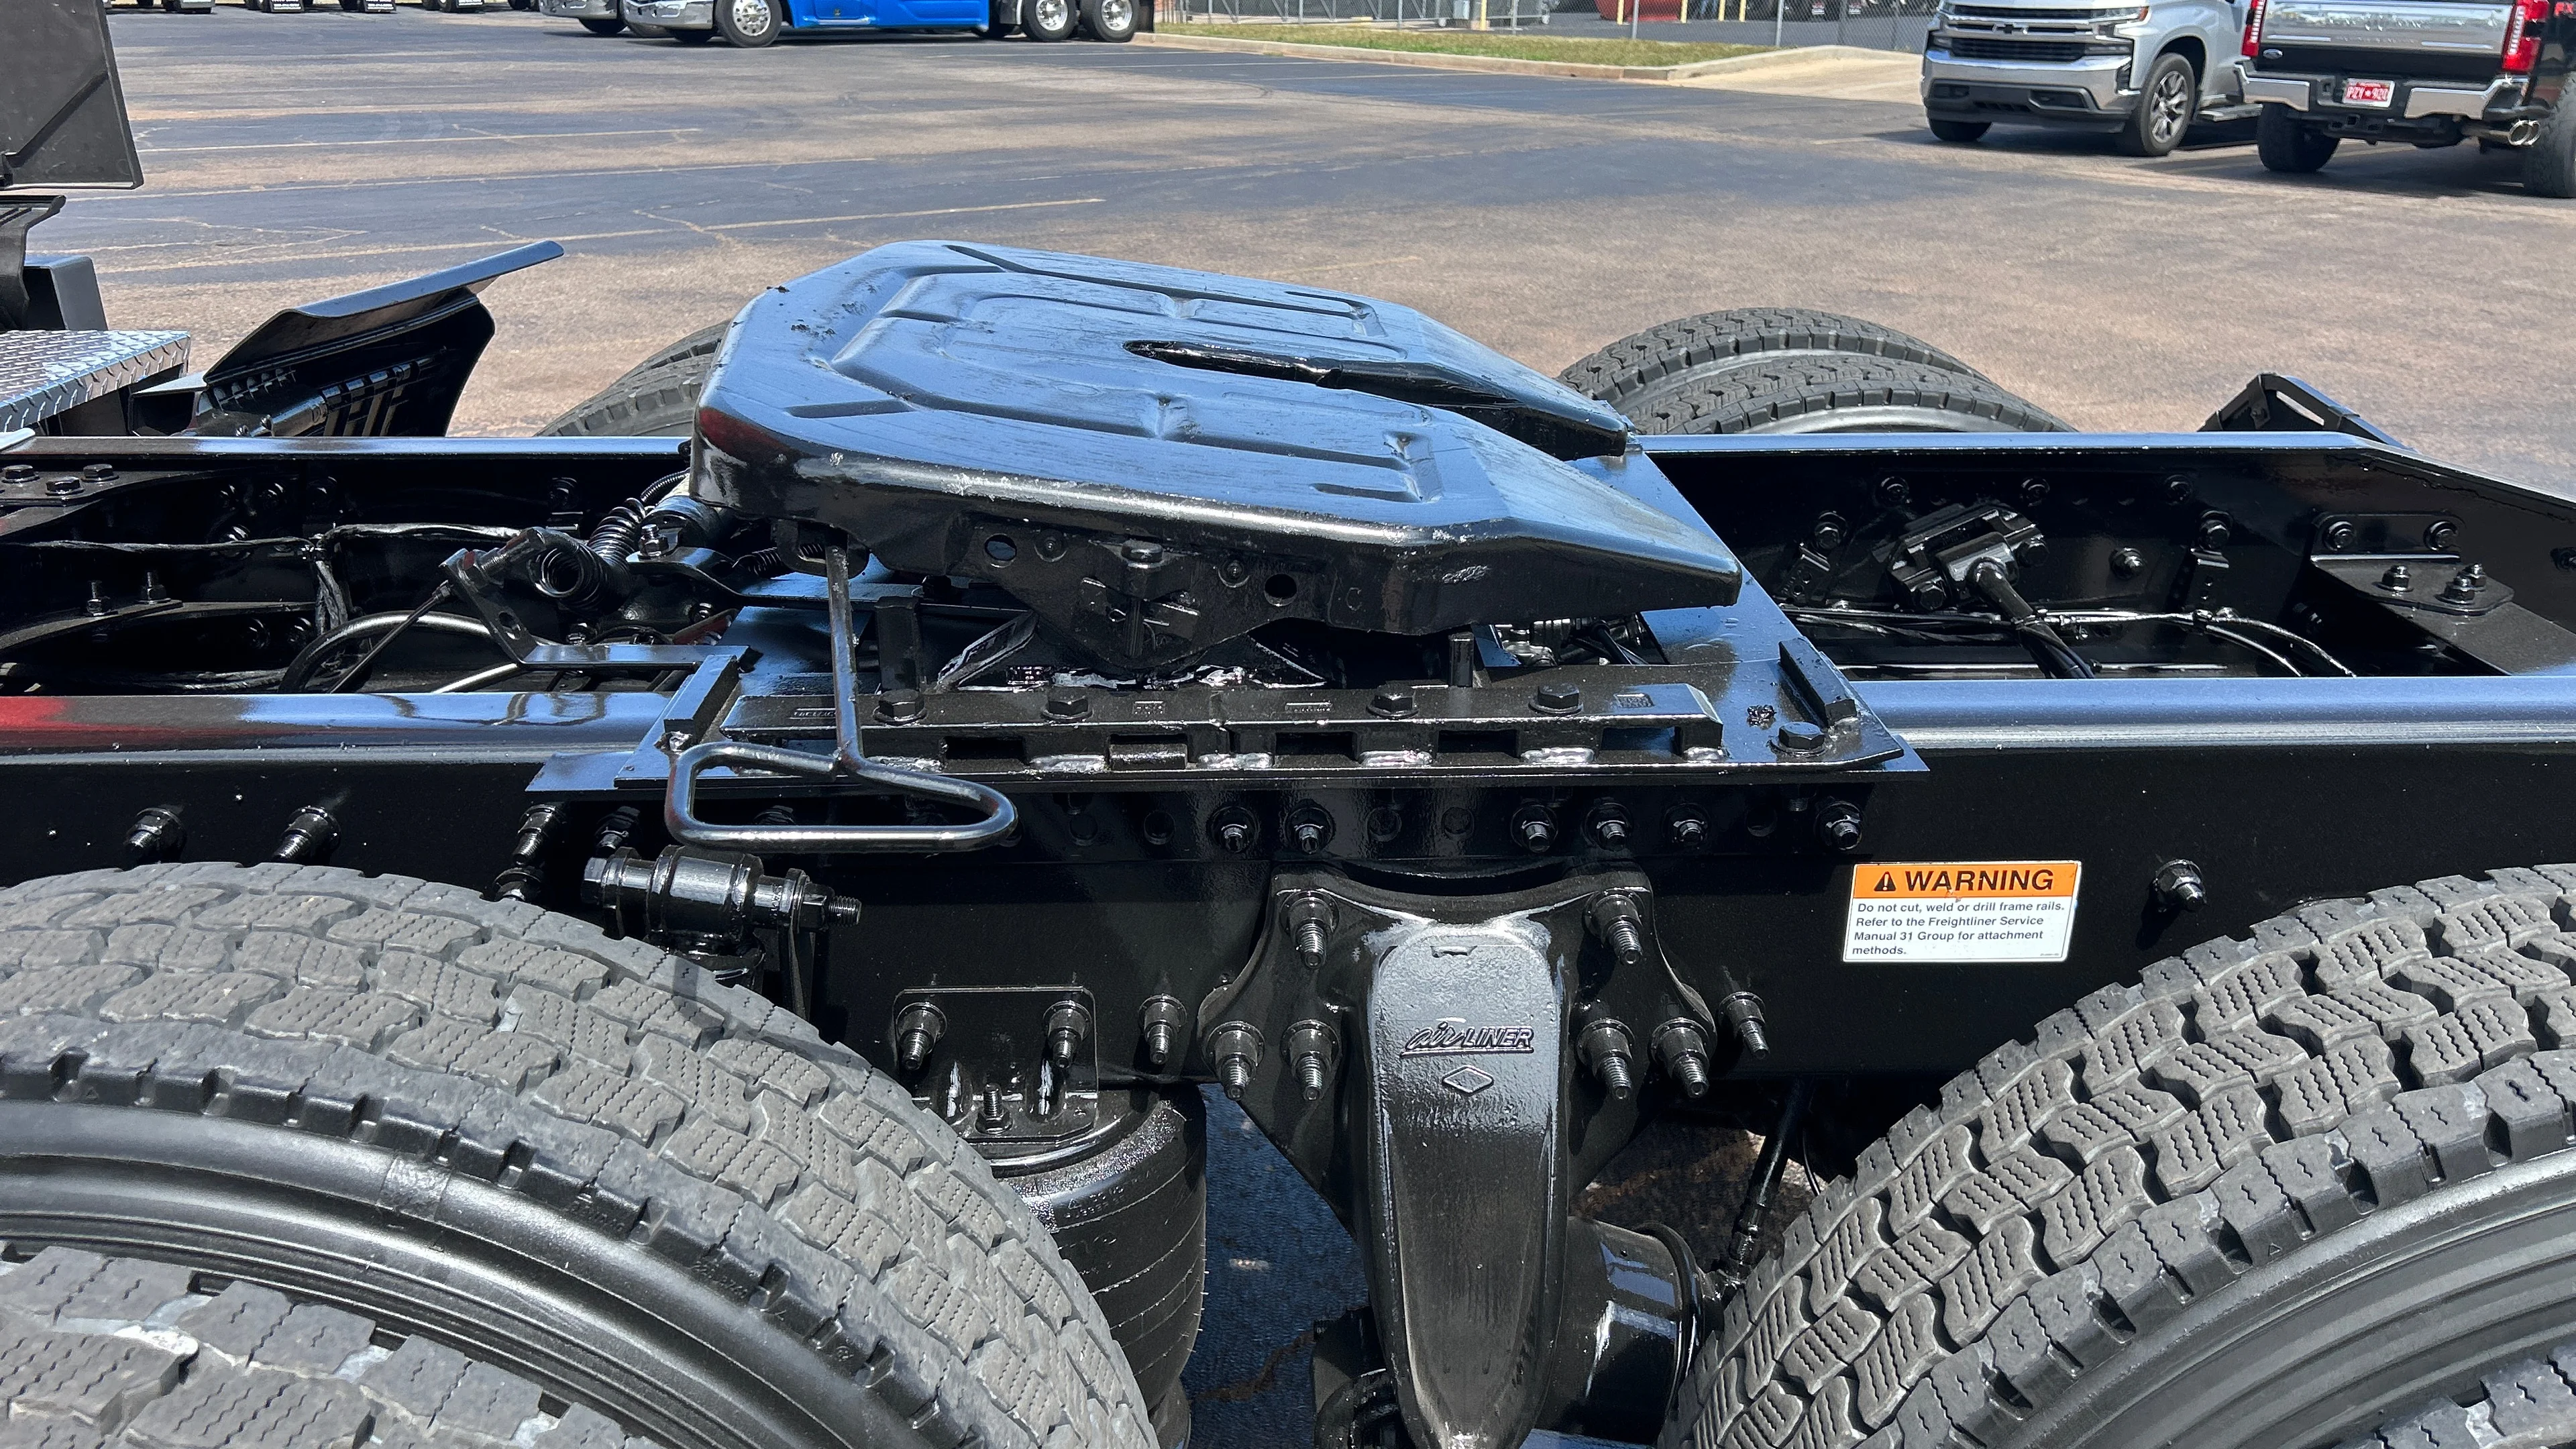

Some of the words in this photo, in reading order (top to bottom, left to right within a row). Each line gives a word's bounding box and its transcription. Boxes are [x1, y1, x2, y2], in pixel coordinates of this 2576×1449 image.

[1905, 869, 2053, 892] WARNING
[1858, 903, 1874, 912] Do
[1877, 904, 1897, 912] not
[1900, 903, 1922, 914] cut,
[1926, 902, 1954, 912] weld
[1973, 902, 1996, 912] drill
[1999, 902, 2033, 911] frame
[2036, 901, 2064, 911] rails.
[1856, 917, 1888, 926] Refer
[1891, 918, 1902, 926] to
[1906, 917, 1925, 926] the
[1928, 916, 1997, 928] Freightliner
[2000, 916, 2044, 926] Service
[1854, 931, 1897, 941] Manual
[1899, 932, 1913, 941] 31
[1917, 931, 1954, 943] Group
[1957, 931, 1975, 941] for
[1977, 930, 2043, 940] attachment
[1852, 945, 1907, 955] methods.
